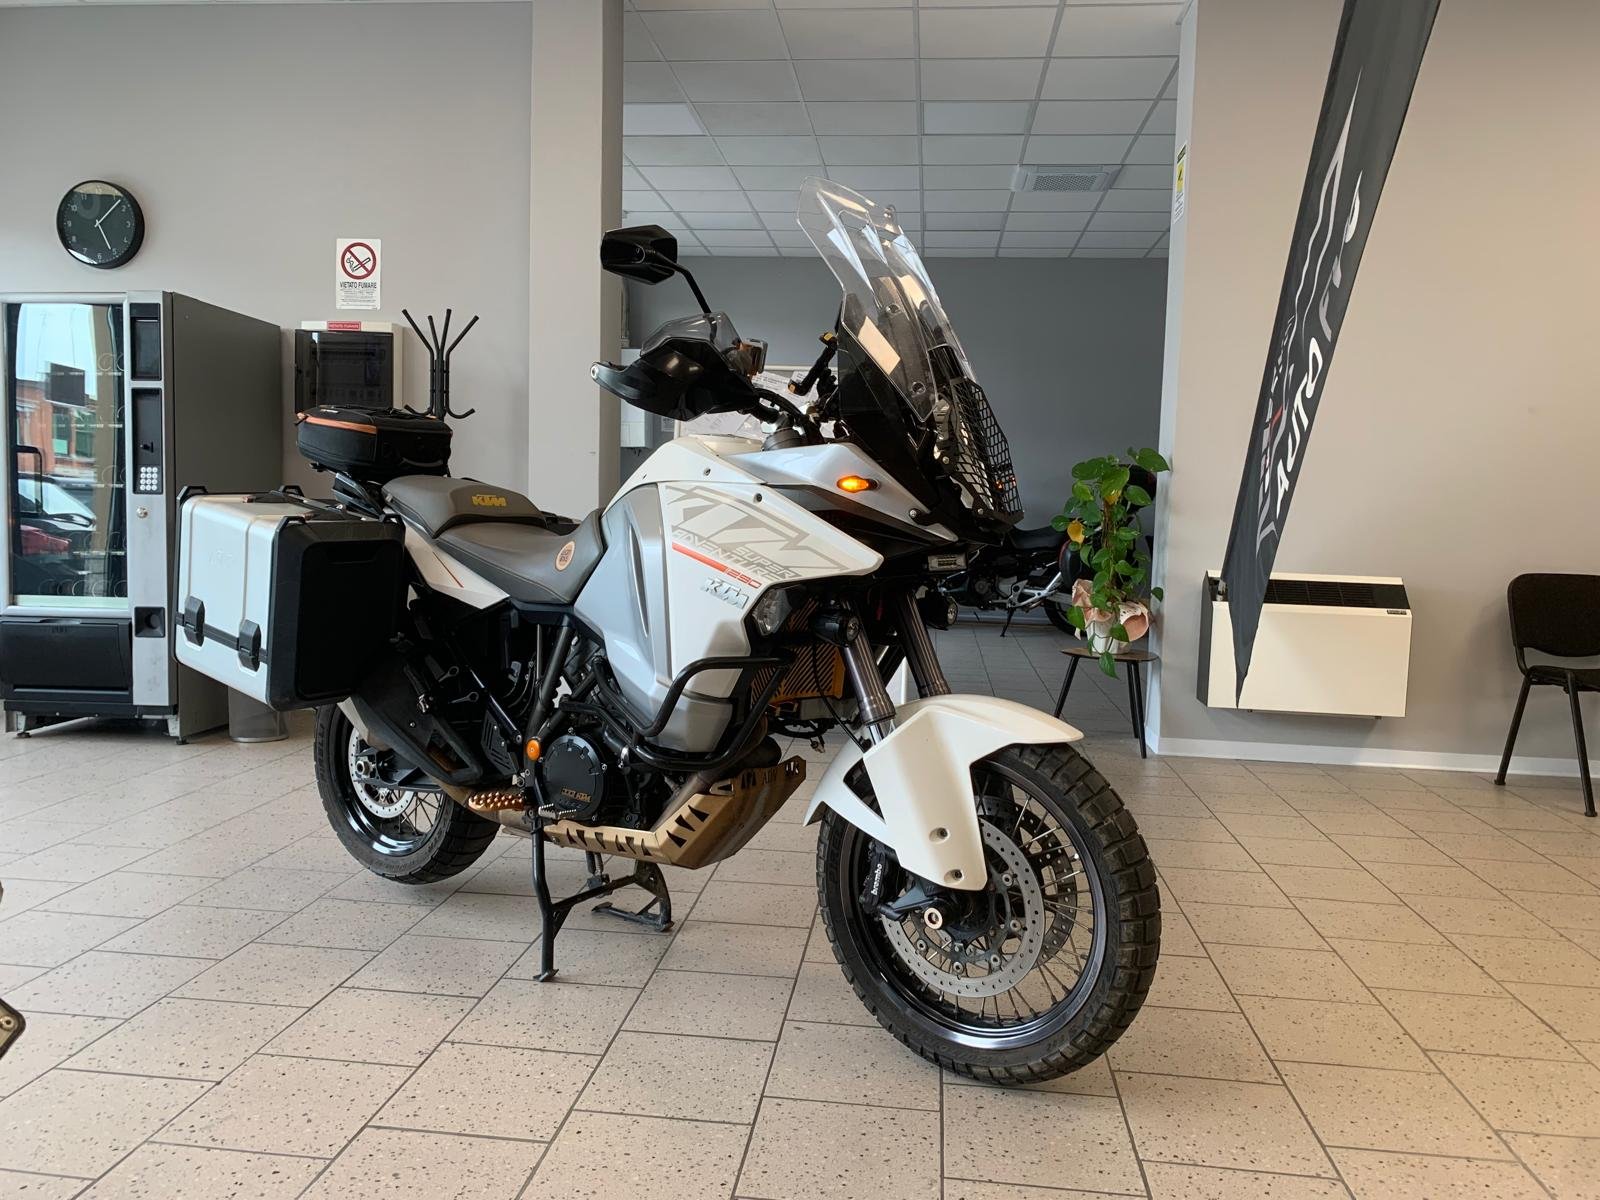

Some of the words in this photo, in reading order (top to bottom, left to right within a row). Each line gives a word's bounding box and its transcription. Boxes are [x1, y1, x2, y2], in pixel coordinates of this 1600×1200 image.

[340, 281, 357, 289] VIETATO
[358, 281, 377, 289] FUMARE
[471, 494, 508, 507] KTM
[671, 528, 783, 582] ADVENTURE
[734, 546, 803, 580] SUPER
[701, 576, 750, 610] KTM
[870, 863, 883, 896] brembo
